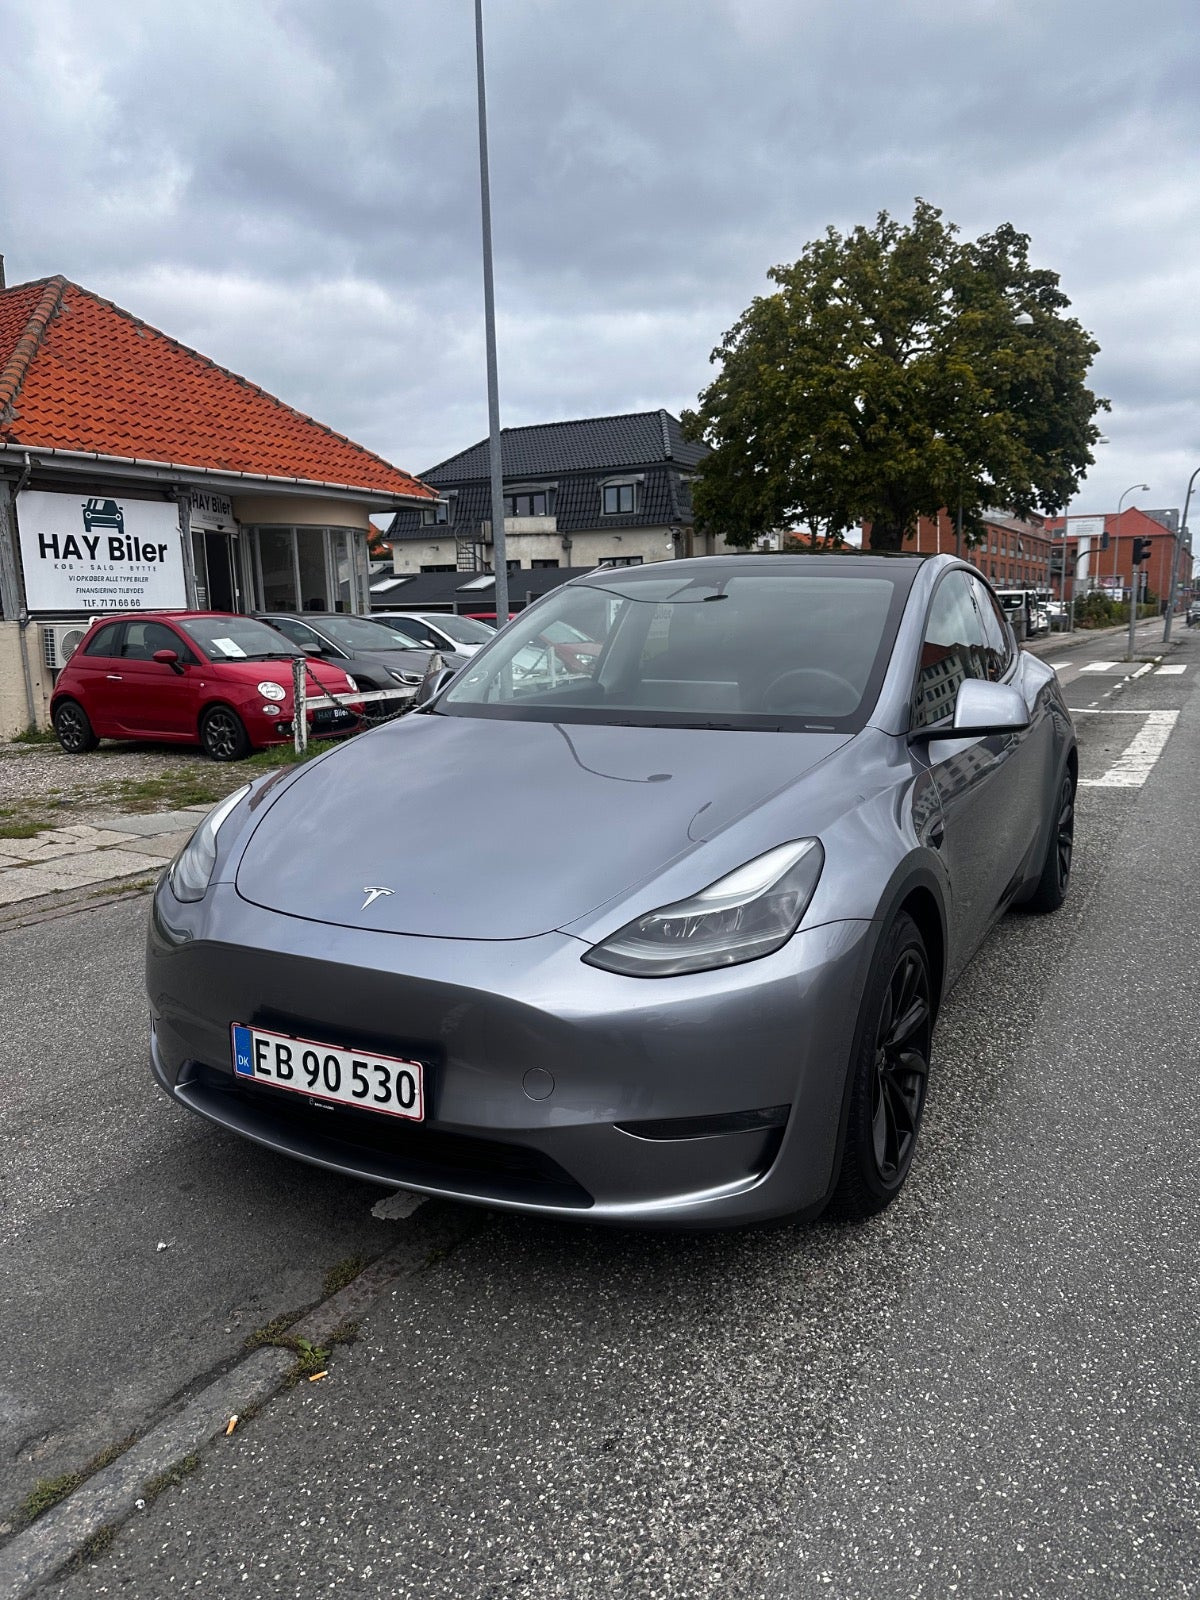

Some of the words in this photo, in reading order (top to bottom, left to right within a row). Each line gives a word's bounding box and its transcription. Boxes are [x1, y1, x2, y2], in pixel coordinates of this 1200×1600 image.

[192, 492, 210, 510] HAY
[211, 495, 230, 515] Biler
[38, 533, 100, 560] HAY
[108, 534, 168, 562] Biler
[83, 599, 99, 607] TLF.
[100, 599, 108, 607] 71
[109, 599, 117, 607] 71
[118, 599, 129, 607] 66
[130, 599, 141, 607] 66
[238, 1055, 249, 1067] DK
[255, 1038, 294, 1080] EB
[302, 1050, 342, 1093] 90
[352, 1060, 417, 1109] 530
